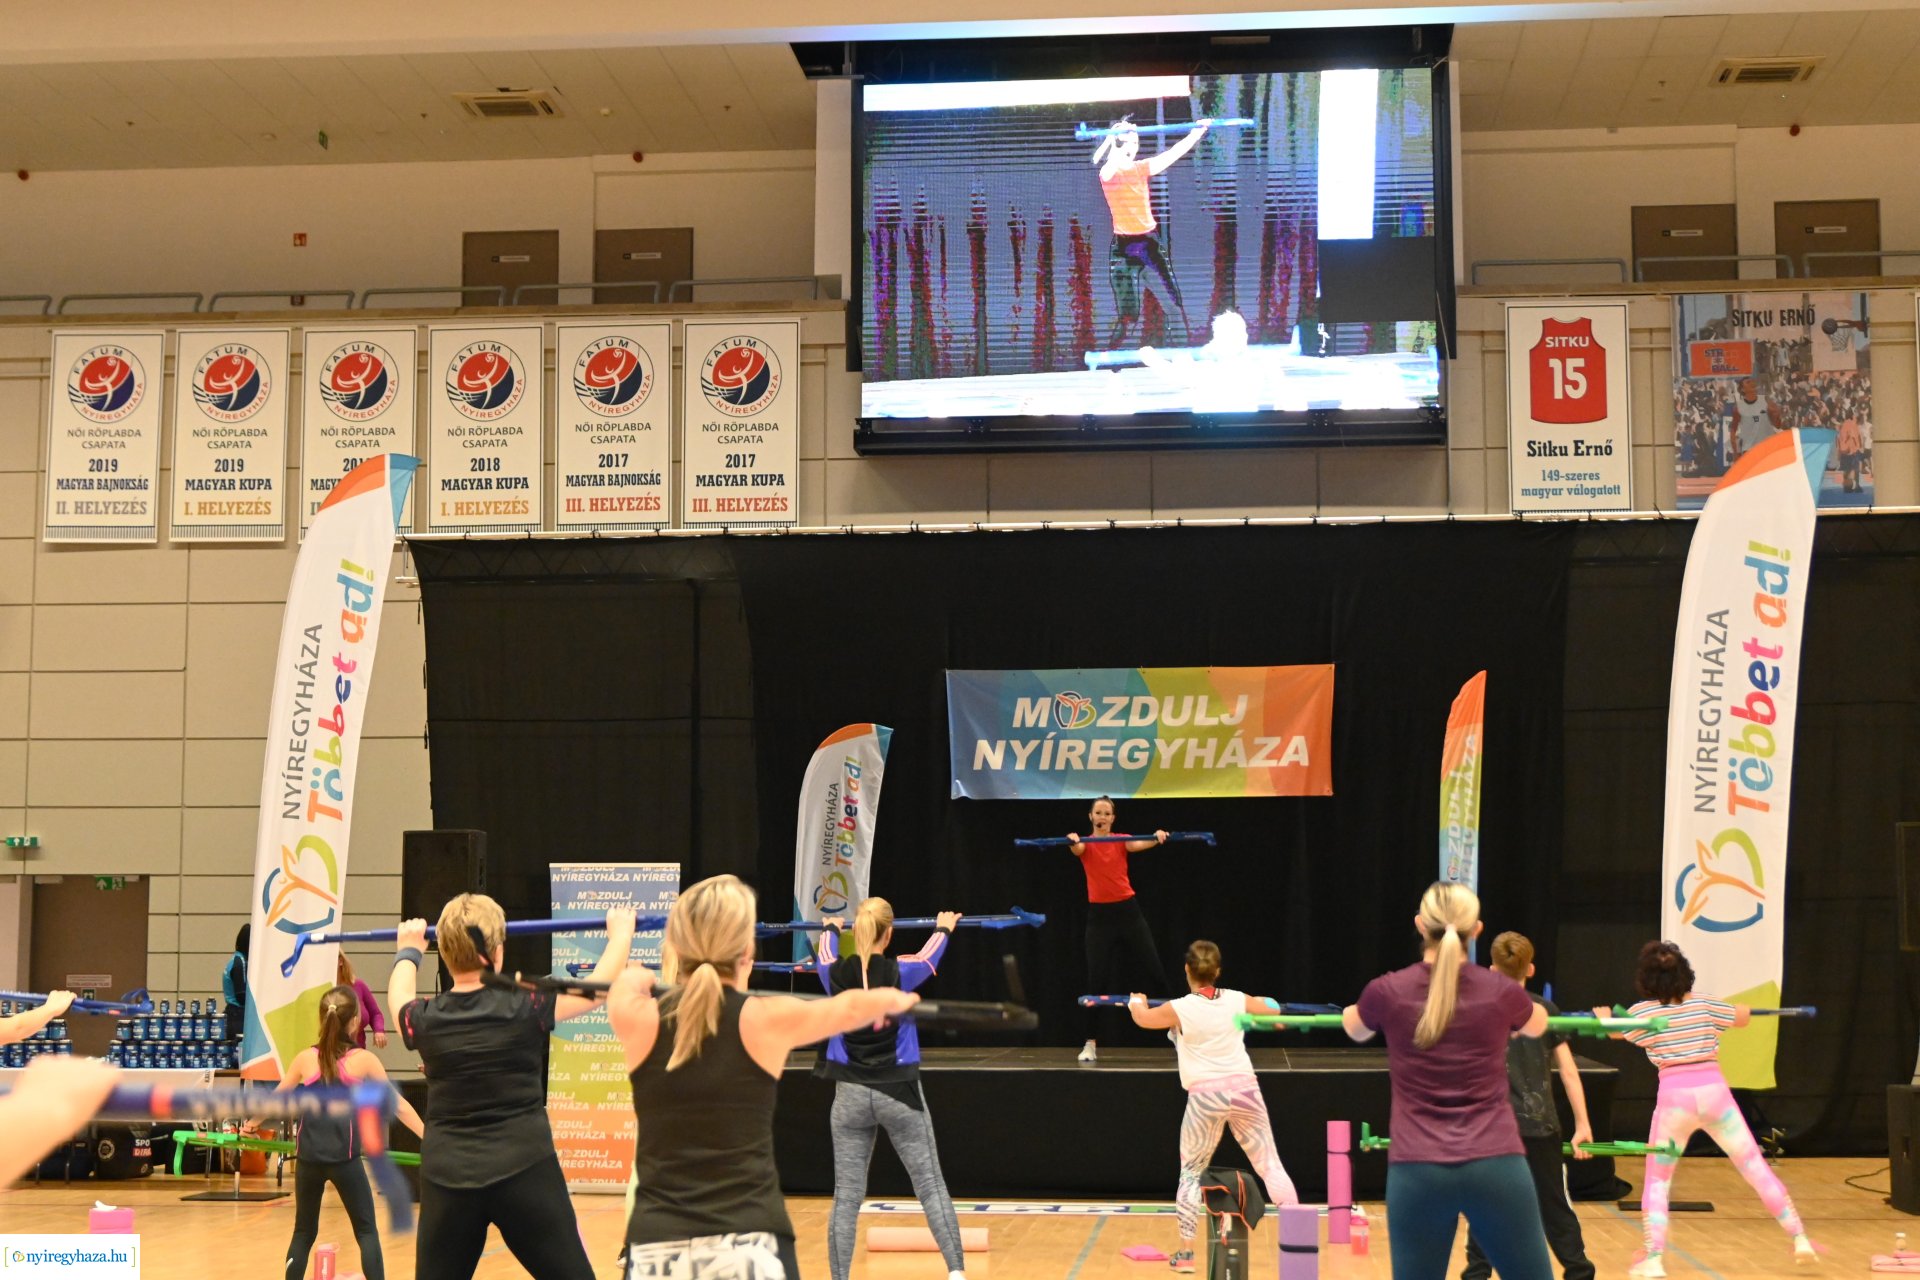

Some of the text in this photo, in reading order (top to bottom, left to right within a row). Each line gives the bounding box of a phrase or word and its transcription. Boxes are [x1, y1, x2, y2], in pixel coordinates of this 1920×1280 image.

[1731, 304, 1816, 328] SITKU ERNŐ
[1545, 336, 1590, 347] SITKU
[73, 348, 123, 374] FATUM
[198, 346, 247, 374] FATUM
[325, 344, 375, 372] FATUM
[452, 344, 501, 372] FATUM
[579, 339, 629, 367] FATUM
[706, 338, 757, 367] FATUM
[1548, 357, 1588, 399] 15
[82, 440, 126, 449] CSAPATA
[207, 440, 252, 449] CSAPATA
[335, 439, 380, 448] CSAPATA
[462, 439, 508, 448] CSAPATA
[590, 435, 636, 444] CSAPATA
[717, 435, 763, 444] CSAPATA
[1526, 438, 1613, 457] Sitku Ernő
[88, 458, 118, 472] 2019
[214, 458, 244, 472] 2019
[470, 457, 501, 472] 2018
[598, 453, 629, 468] 2017
[725, 453, 756, 468] 2017
[56, 475, 149, 492] MAGYAR BAJNOKSÁG
[185, 478, 272, 490] MAGYAR KUPA
[441, 477, 529, 491] MAGYAR KUPA
[566, 469, 661, 488] MAGYAR BAJNOKSÁG
[696, 473, 785, 487] MAGYAR KUPA
[1541, 469, 1600, 482] 149-szeres
[1521, 483, 1621, 499] magyar válogatott
[56, 496, 147, 515] II. HELYEZÉS
[184, 496, 272, 515] I. HELYEZÉS
[441, 495, 529, 516] I. HELYEZÉS
[566, 491, 661, 512] III. HELYEZÉS
[692, 492, 788, 512] III. HELYEZÉS
[1728, 540, 1791, 816] Többet ad!
[306, 558, 375, 824] Többet ad!
[1690, 608, 1730, 813] NYÍREGYHÁZA
[282, 623, 324, 820] NYÍREGYHÁZA
[972, 730, 1310, 771] NYÍREGYHÁZA
[820, 782, 840, 866] NYÍREGYHÁZA
[835, 793, 859, 867] Többet
[552, 872, 630, 882] NYÍREGYHÁZA
